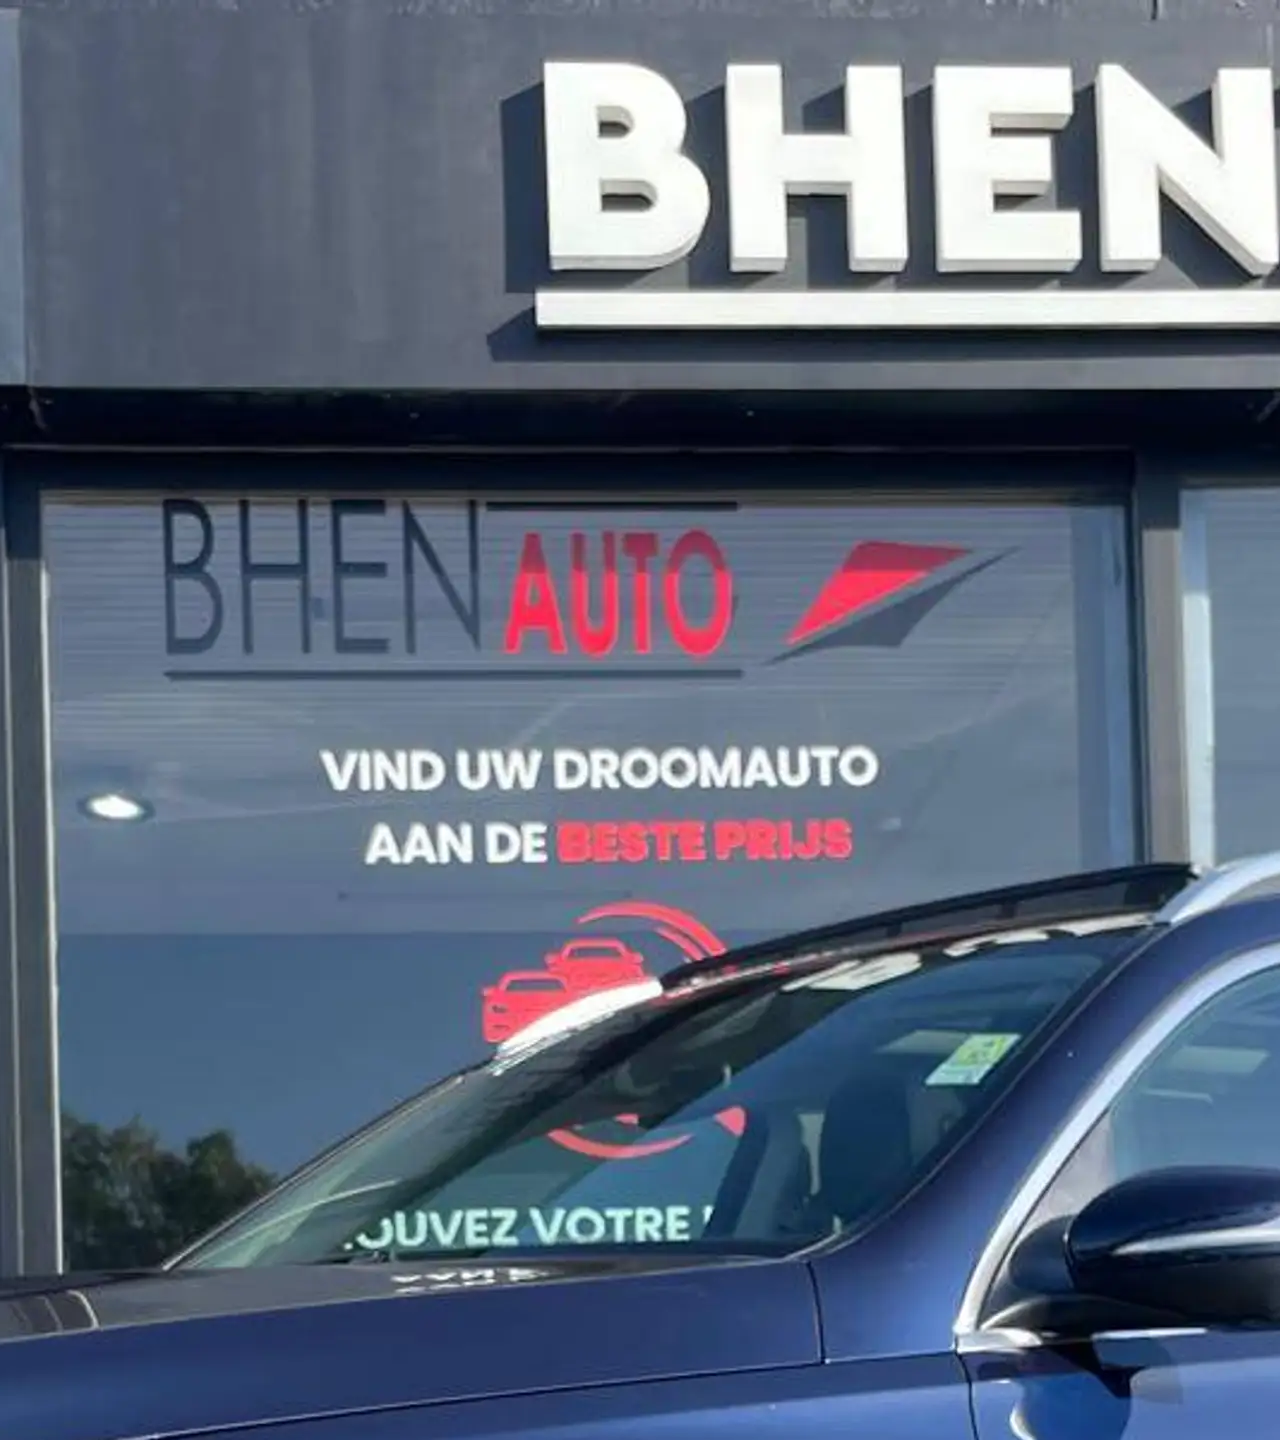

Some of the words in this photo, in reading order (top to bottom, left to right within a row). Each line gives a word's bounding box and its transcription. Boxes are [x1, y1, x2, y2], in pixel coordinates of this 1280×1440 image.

[543, 61, 1280, 276] BHEN
[163, 499, 481, 655] BHEN
[505, 530, 733, 658] AUTO
[320, 748, 446, 792] VIND
[455, 748, 543, 791] UW
[552, 744, 880, 791] DROOMAUTO
[364, 822, 473, 865] AAN
[484, 822, 548, 864] DE
[555, 820, 706, 863] BESTE
[711, 817, 853, 861] PRIJS
[528, 1204, 691, 1245] VOTRE
